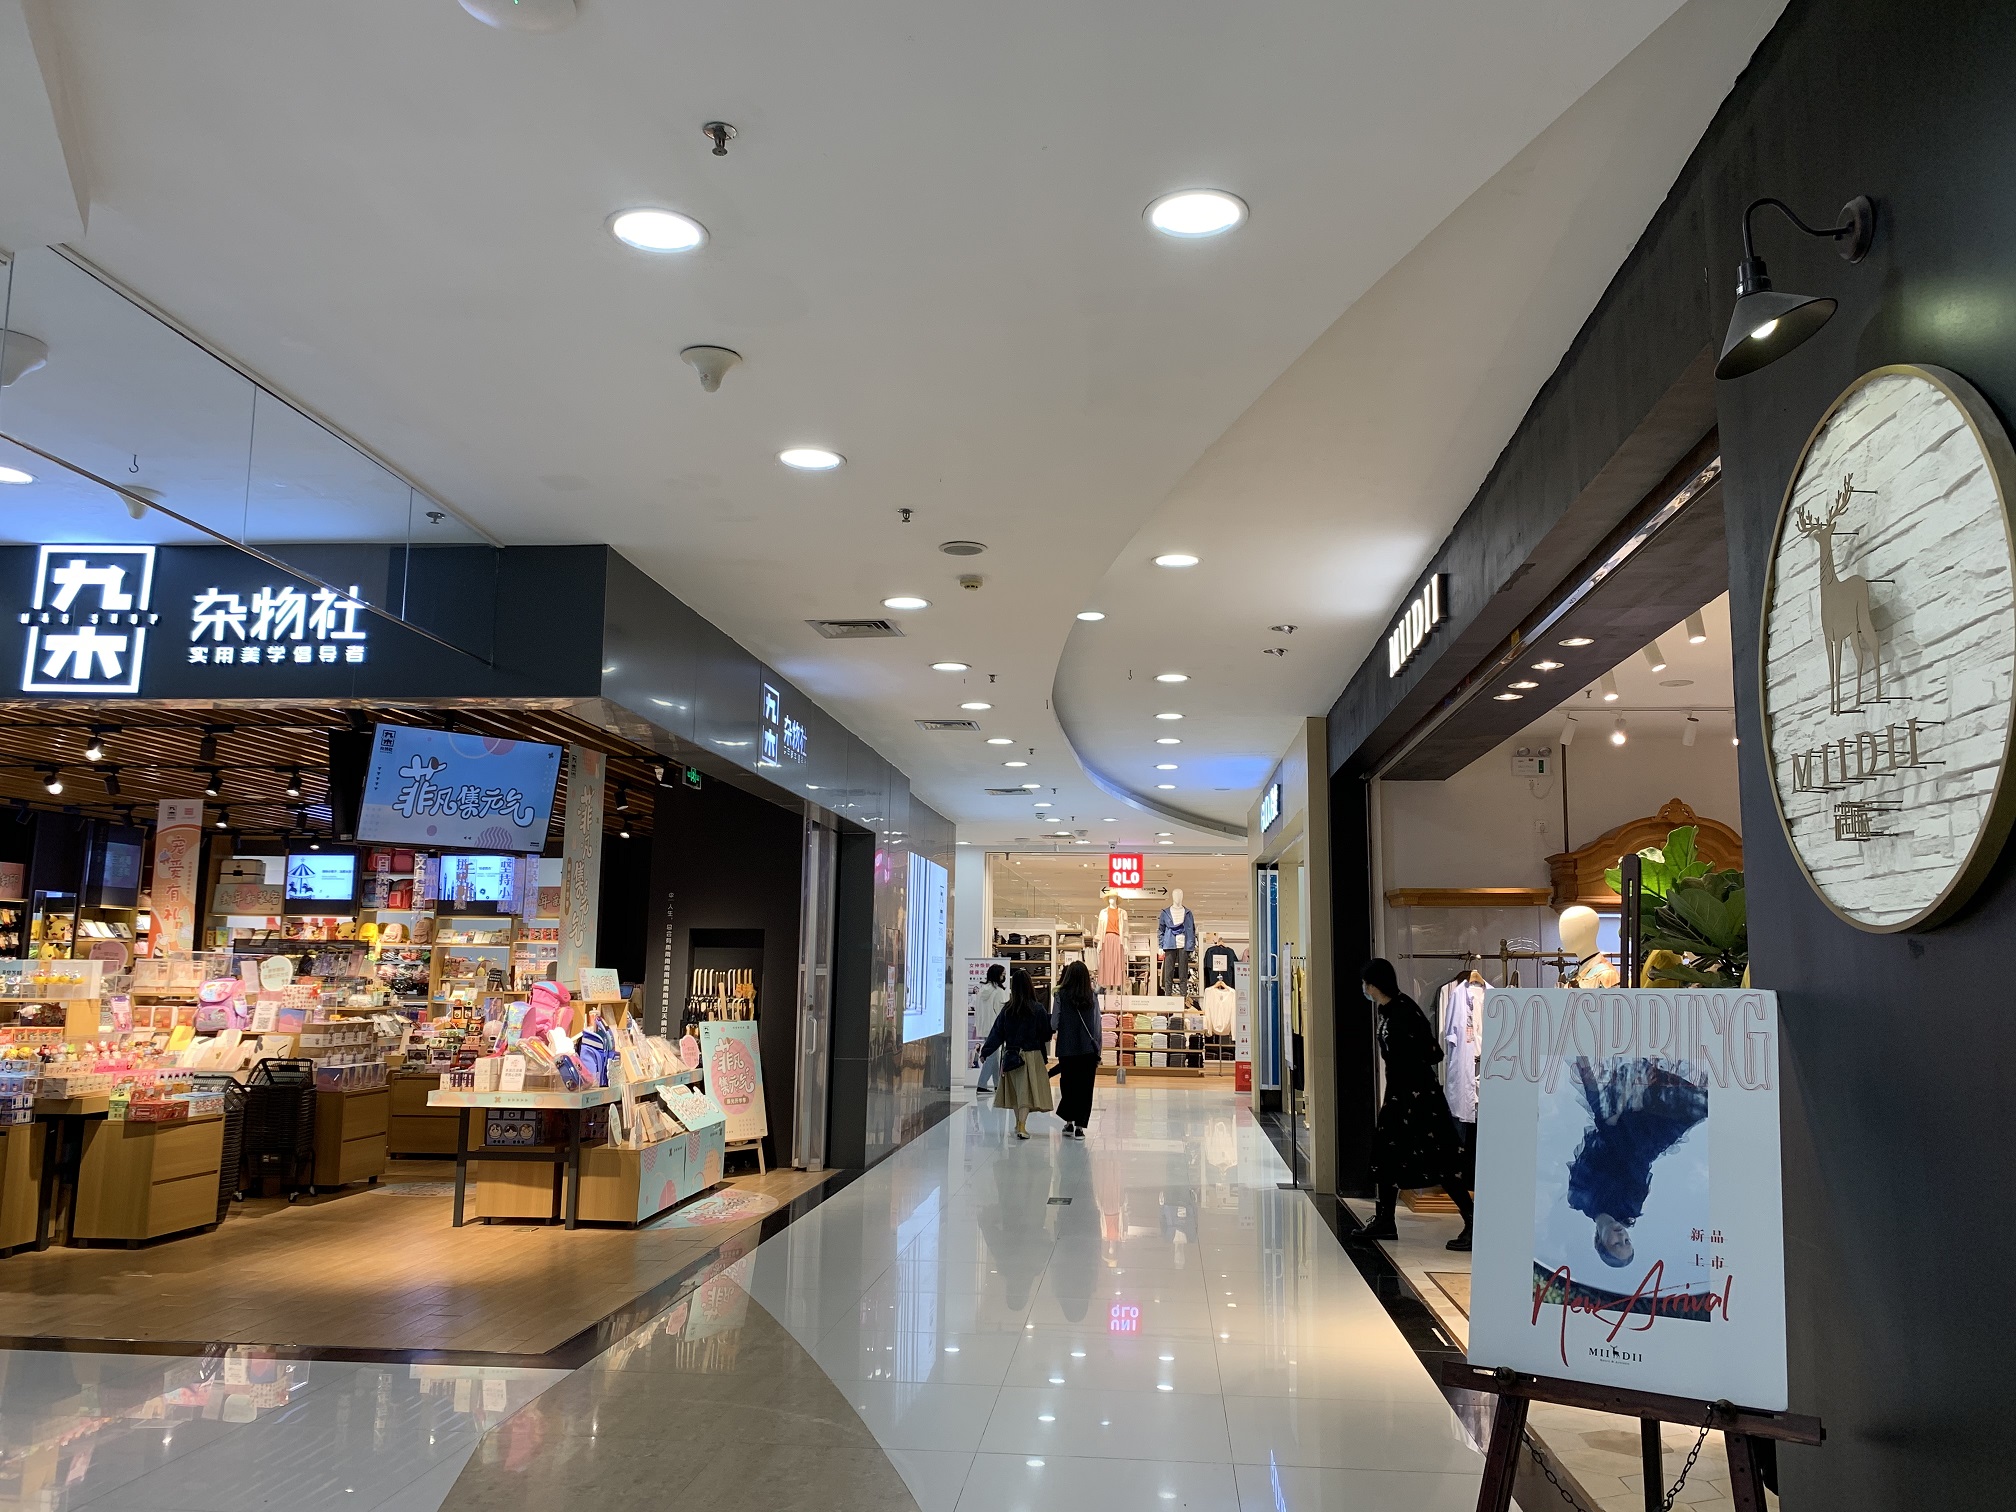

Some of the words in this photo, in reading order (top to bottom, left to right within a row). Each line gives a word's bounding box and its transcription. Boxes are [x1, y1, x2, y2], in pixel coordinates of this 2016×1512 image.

[191, 585, 367, 642] 杂物社
[187, 645, 367, 664] 实用美学倡导者
[1790, 717, 1919, 794] MIIDII
[163, 835, 186, 922] 宠爱有礼
[1112, 857, 1138, 871] UNI
[1112, 871, 1141, 886] QLO
[1484, 991, 1773, 1094] 20/SPRING
[1532, 1265, 1602, 1367] New
[1594, 1259, 1733, 1343] Arrival
